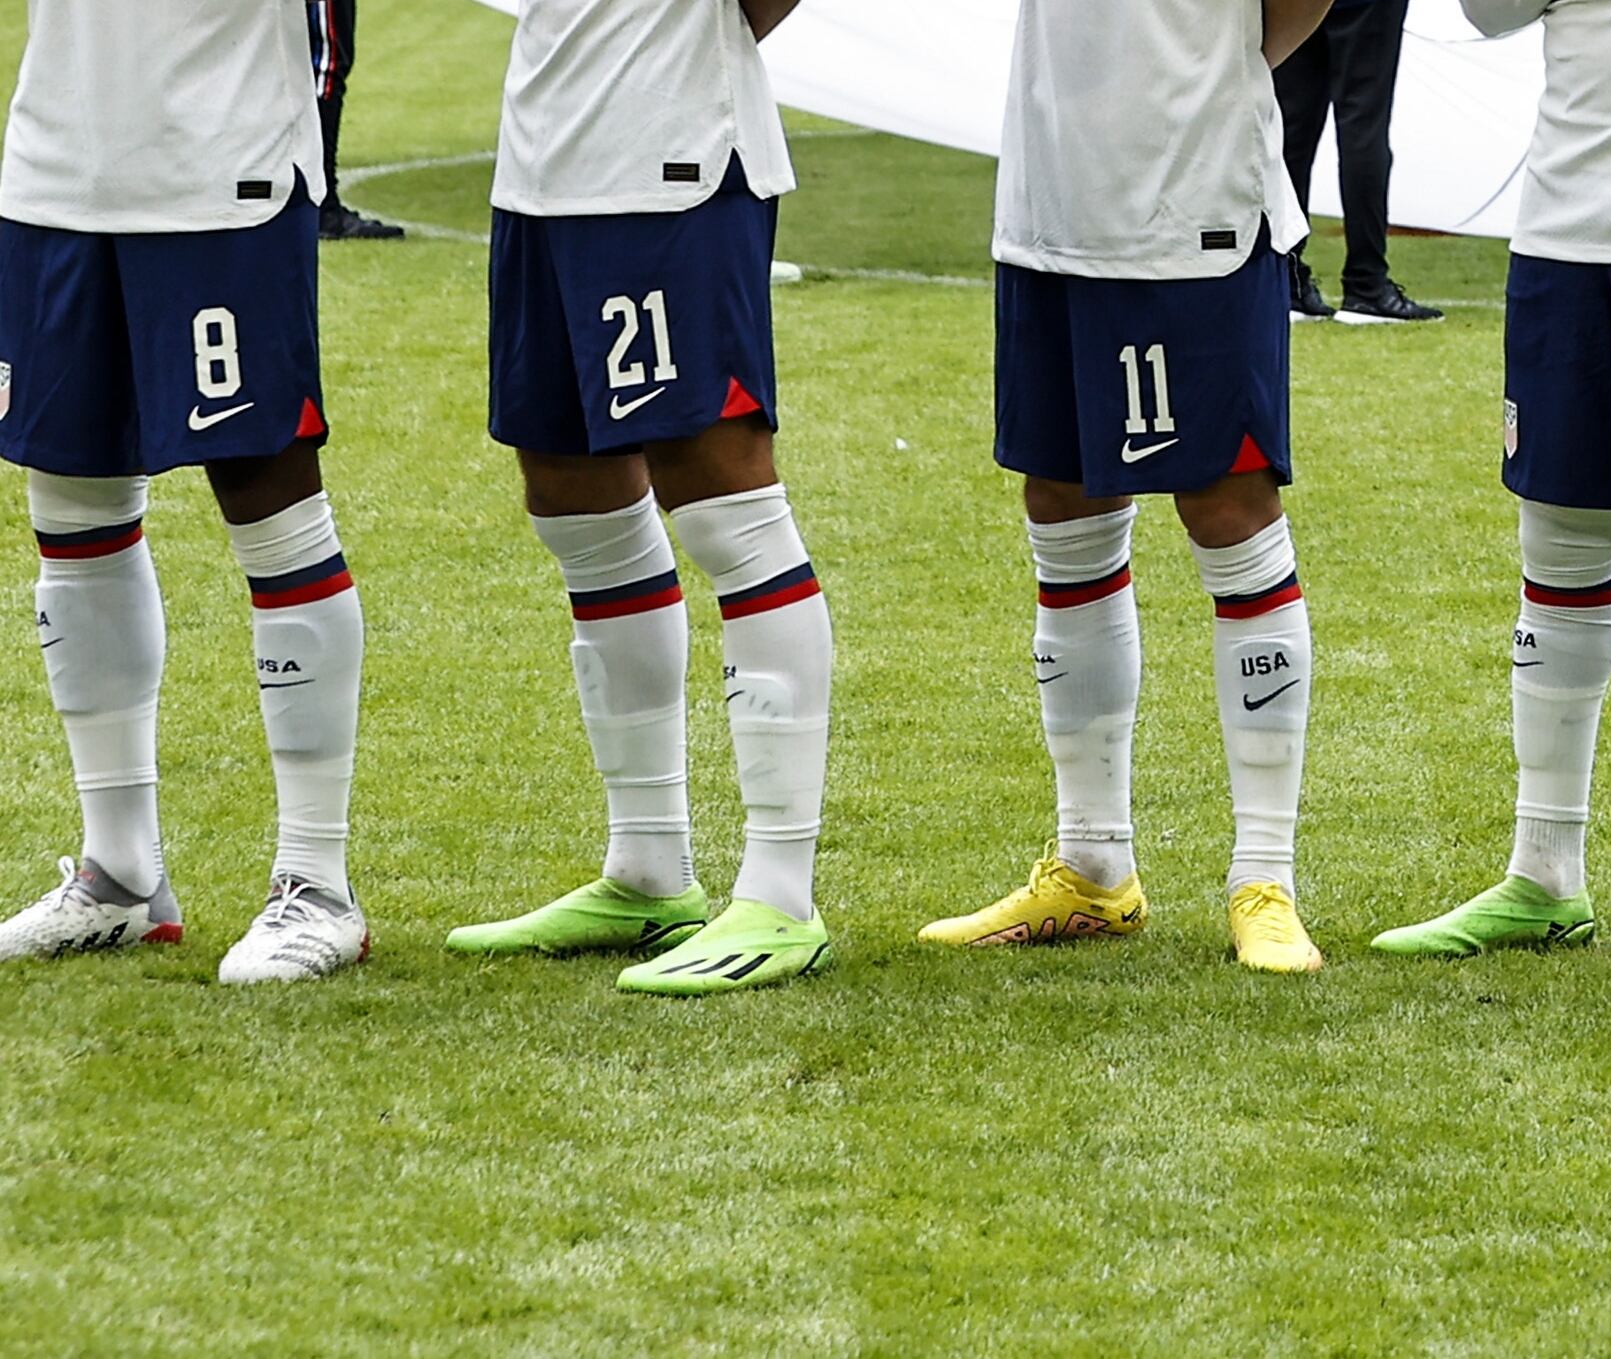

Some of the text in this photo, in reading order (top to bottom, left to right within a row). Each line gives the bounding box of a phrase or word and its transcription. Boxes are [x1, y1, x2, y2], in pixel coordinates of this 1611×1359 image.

[193, 307, 242, 398] 8
[602, 289, 678, 388] 21
[1119, 344, 1176, 434] 11
[1241, 651, 1290, 676] USA
[1514, 630, 1538, 648] SA
